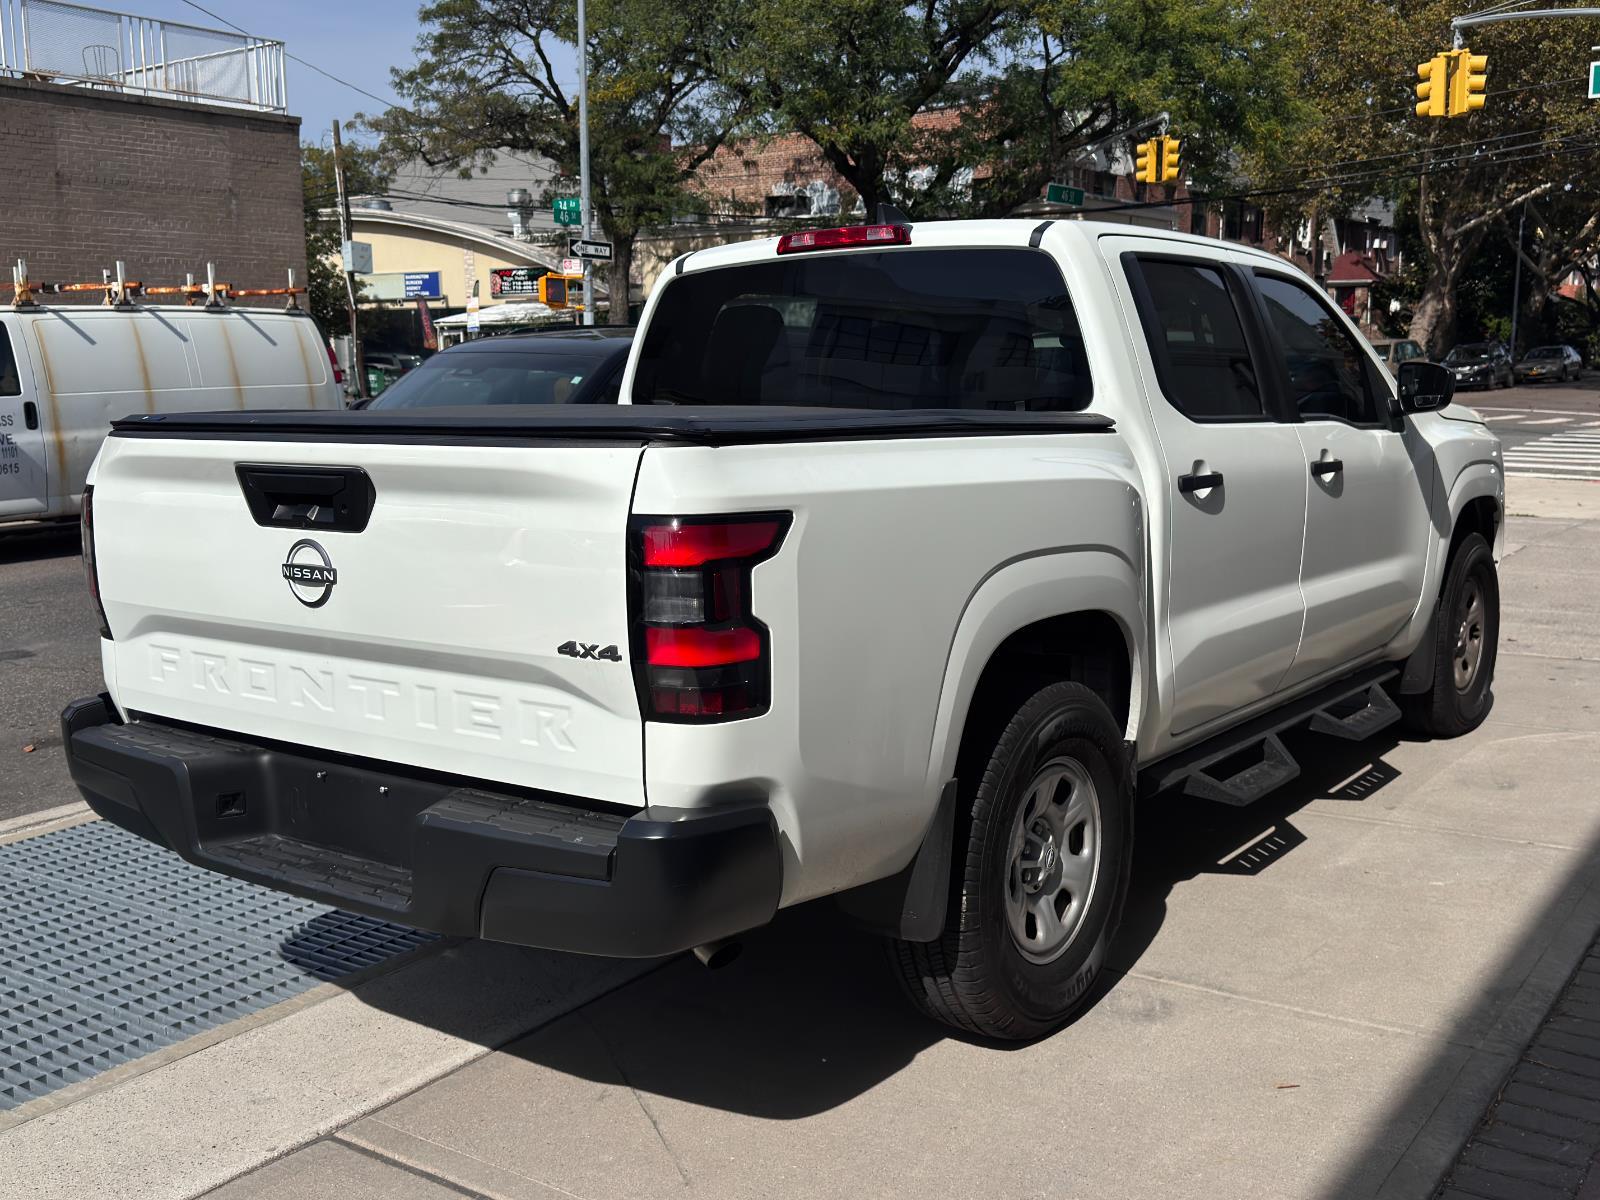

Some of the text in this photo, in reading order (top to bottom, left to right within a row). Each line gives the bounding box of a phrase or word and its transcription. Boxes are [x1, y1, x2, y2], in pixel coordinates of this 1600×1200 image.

[559, 211, 569, 222] 46
[575, 244, 608, 255] ONE WAY
[0, 415, 14, 427] SS
[282, 565, 335, 581] NISSAN
[148, 643, 578, 753] FRONTIER
